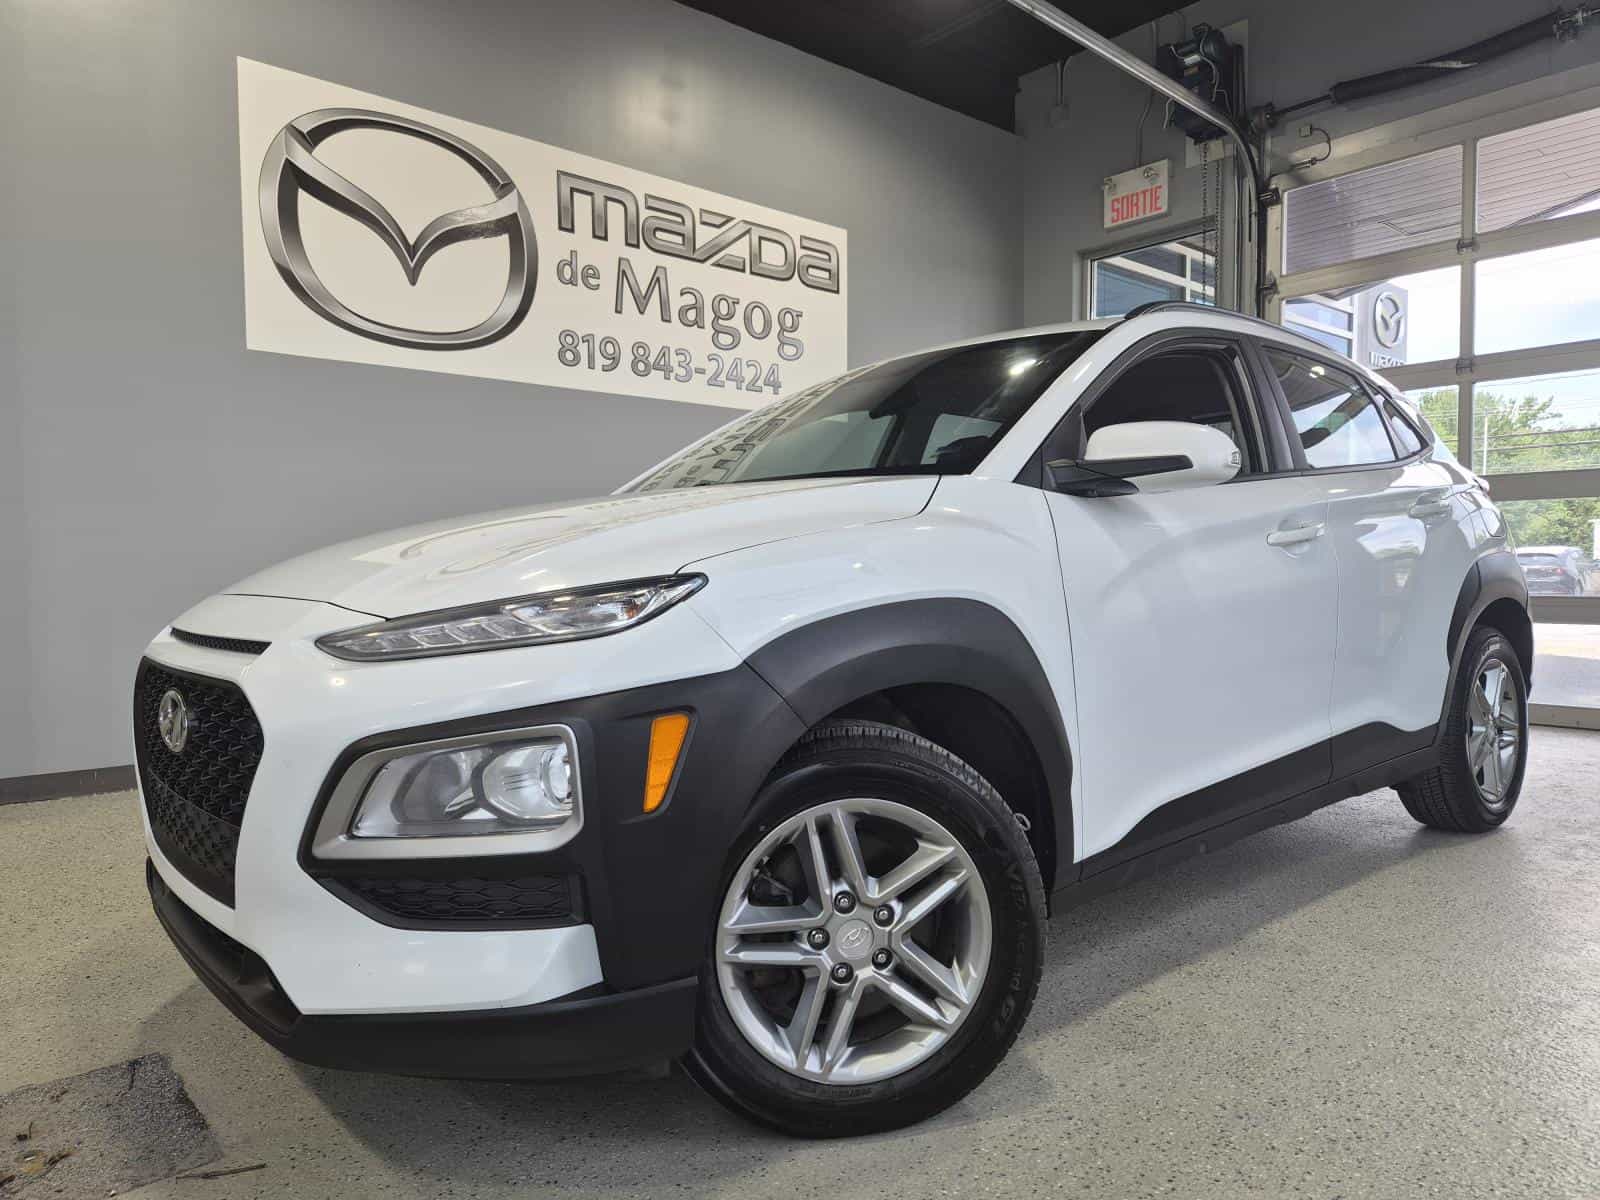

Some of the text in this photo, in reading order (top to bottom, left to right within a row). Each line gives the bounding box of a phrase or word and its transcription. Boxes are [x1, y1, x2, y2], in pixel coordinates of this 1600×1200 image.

[1111, 185, 1163, 224] SORTIE
[556, 250, 804, 361] de Magog
[557, 329, 783, 395] 819 843-2424
